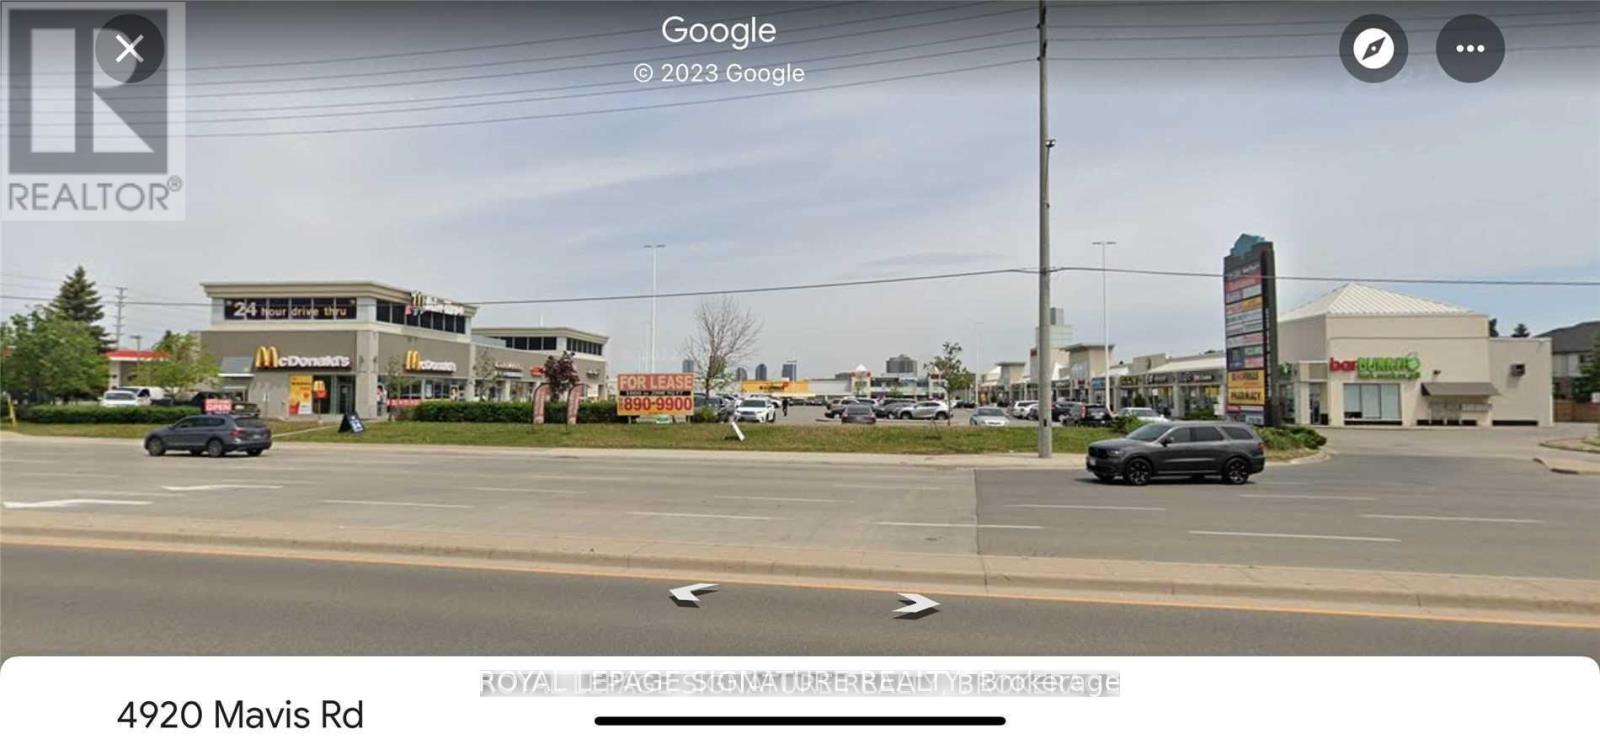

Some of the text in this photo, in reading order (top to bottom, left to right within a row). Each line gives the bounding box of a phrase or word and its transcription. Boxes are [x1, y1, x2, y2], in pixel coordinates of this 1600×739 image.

[233, 301, 347, 316] 24 hour drive thru
[255, 346, 350, 367] McDonald's
[620, 375, 693, 390] FOR LEASE
[624, 396, 693, 411] 890-9900
